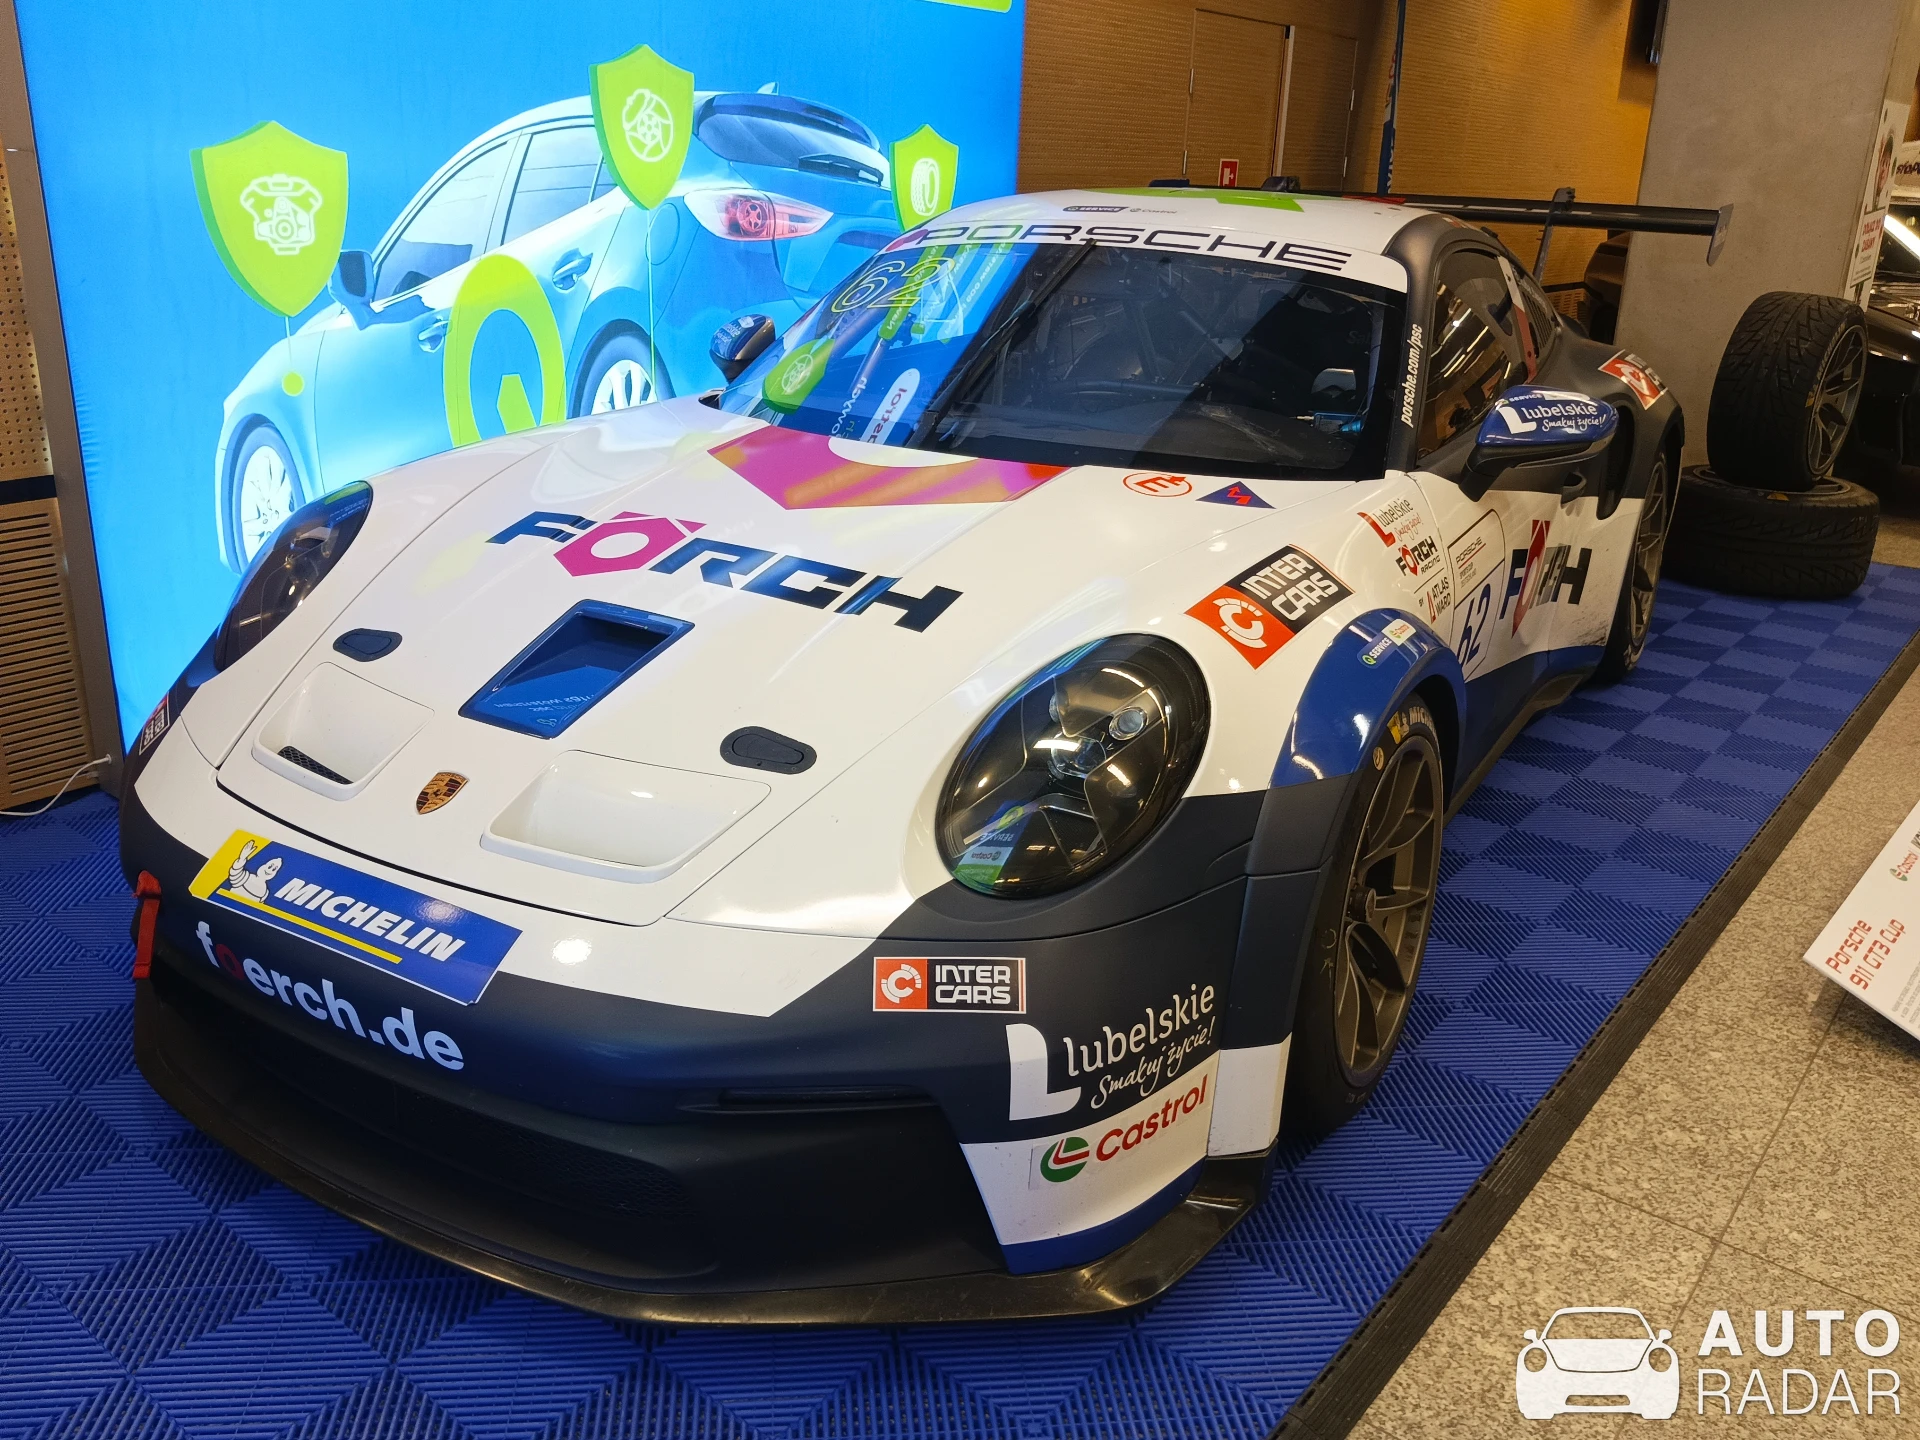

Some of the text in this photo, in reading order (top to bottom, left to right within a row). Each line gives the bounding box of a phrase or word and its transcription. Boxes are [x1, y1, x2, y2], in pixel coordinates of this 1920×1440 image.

[916, 223, 1352, 272] PORSCHE
[831, 257, 956, 313] 62
[1400, 323, 1424, 429] porsche.com/psc
[1522, 402, 1599, 420] lubelskie
[1541, 418, 1576, 432] Smakuj
[1372, 496, 1414, 528] lubelskie
[1420, 553, 1441, 575] RACING
[1455, 535, 1483, 565] PORSCHE
[1239, 552, 1314, 601] INTER
[1271, 571, 1340, 622] CARS
[1431, 576, 1450, 601] ATLAS
[1434, 592, 1453, 617] WARD
[1456, 583, 1492, 670] 62
[1368, 637, 1393, 660] SERVICE
[274, 876, 466, 963] MICHELIN
[1825, 919, 1873, 975] Porsche
[1848, 965, 1875, 991] 911
[1862, 938, 1892, 971] GT3
[1879, 918, 1907, 948] Cup
[196, 920, 465, 1071] foerch.de
[935, 964, 1011, 985] INTER
[935, 985, 1011, 1005] CARS
[1063, 982, 1216, 1077] lubelskie
[1090, 1015, 1217, 1110] Smakuj życie!
[1095, 1074, 1208, 1163] Castrol
